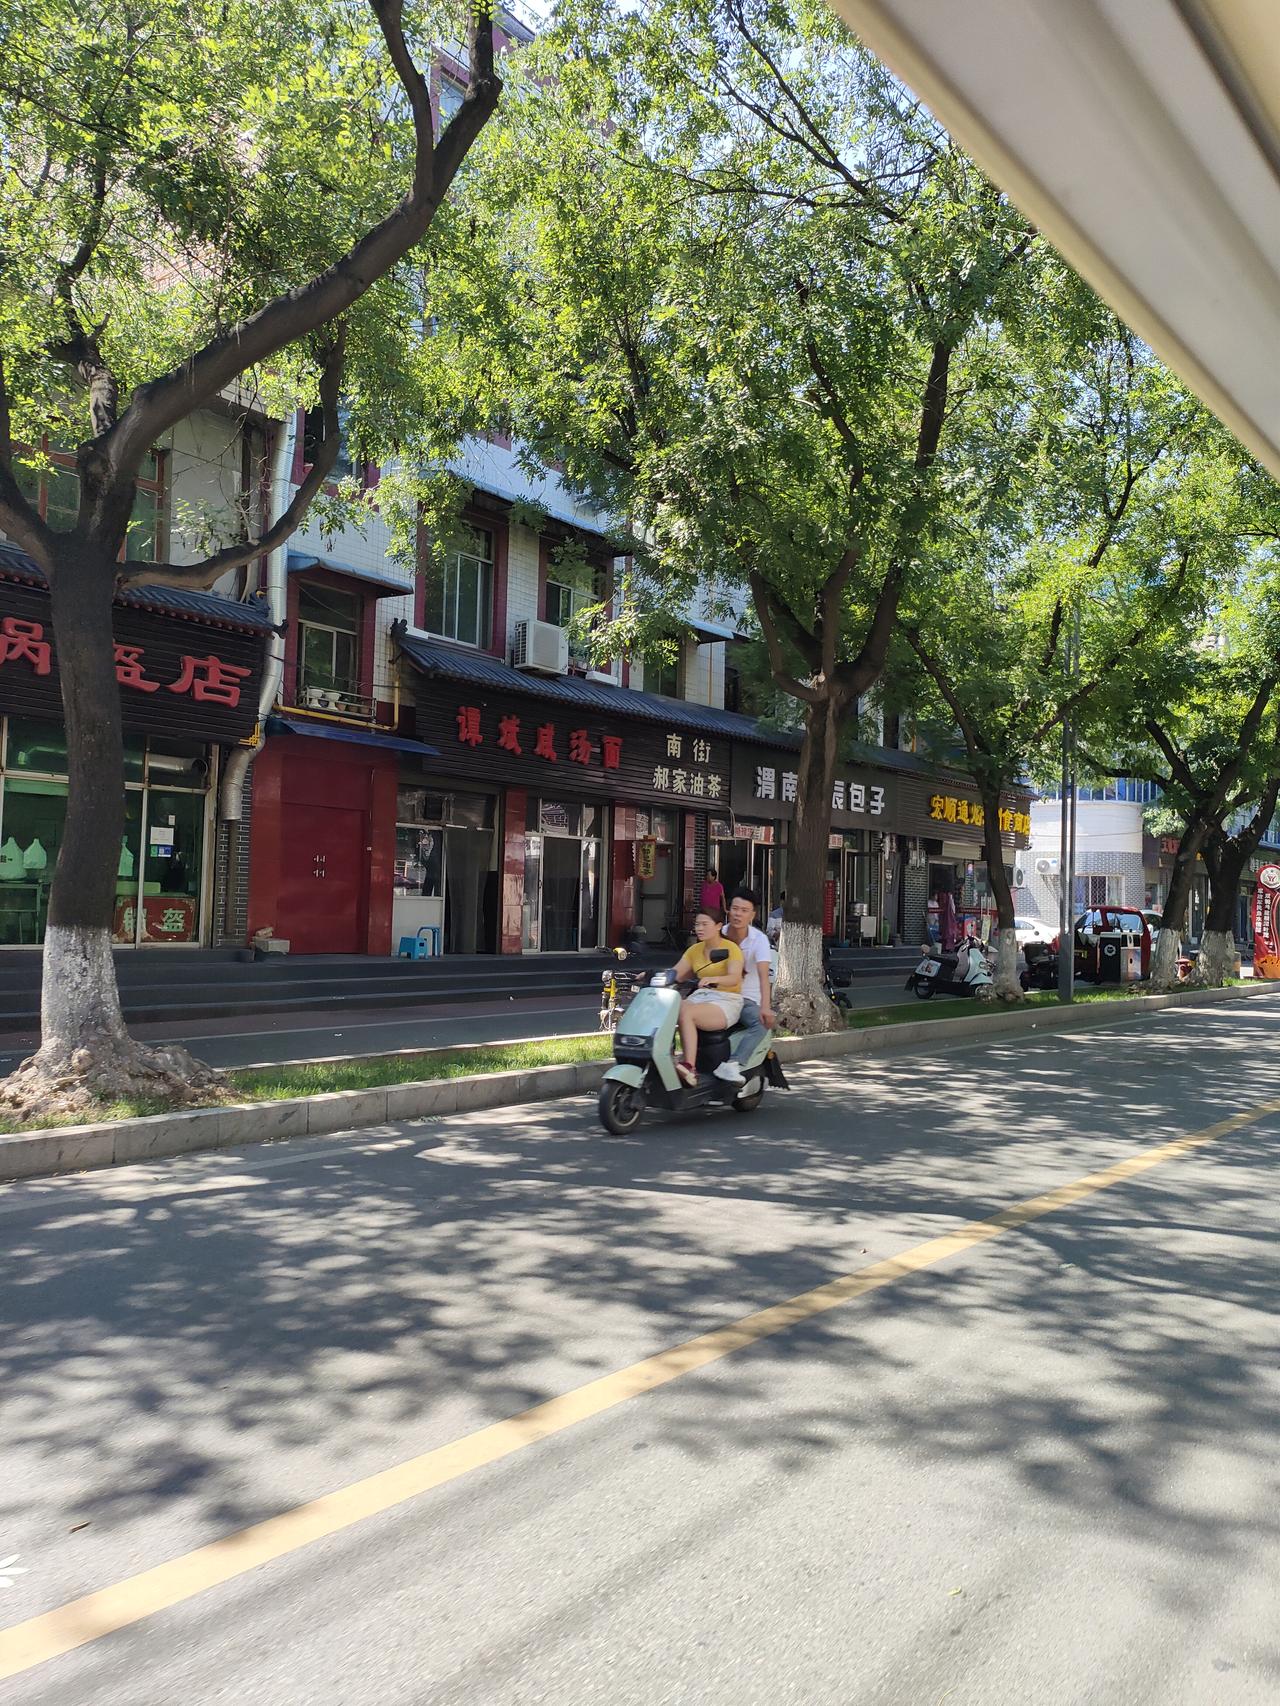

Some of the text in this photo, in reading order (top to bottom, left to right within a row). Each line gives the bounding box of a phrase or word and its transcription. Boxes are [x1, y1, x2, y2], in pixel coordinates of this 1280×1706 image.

[666, 733, 711, 763] 南街
[652, 764, 723, 799] 郝家油茶
[756, 766, 885, 815] 渭南辰包子
